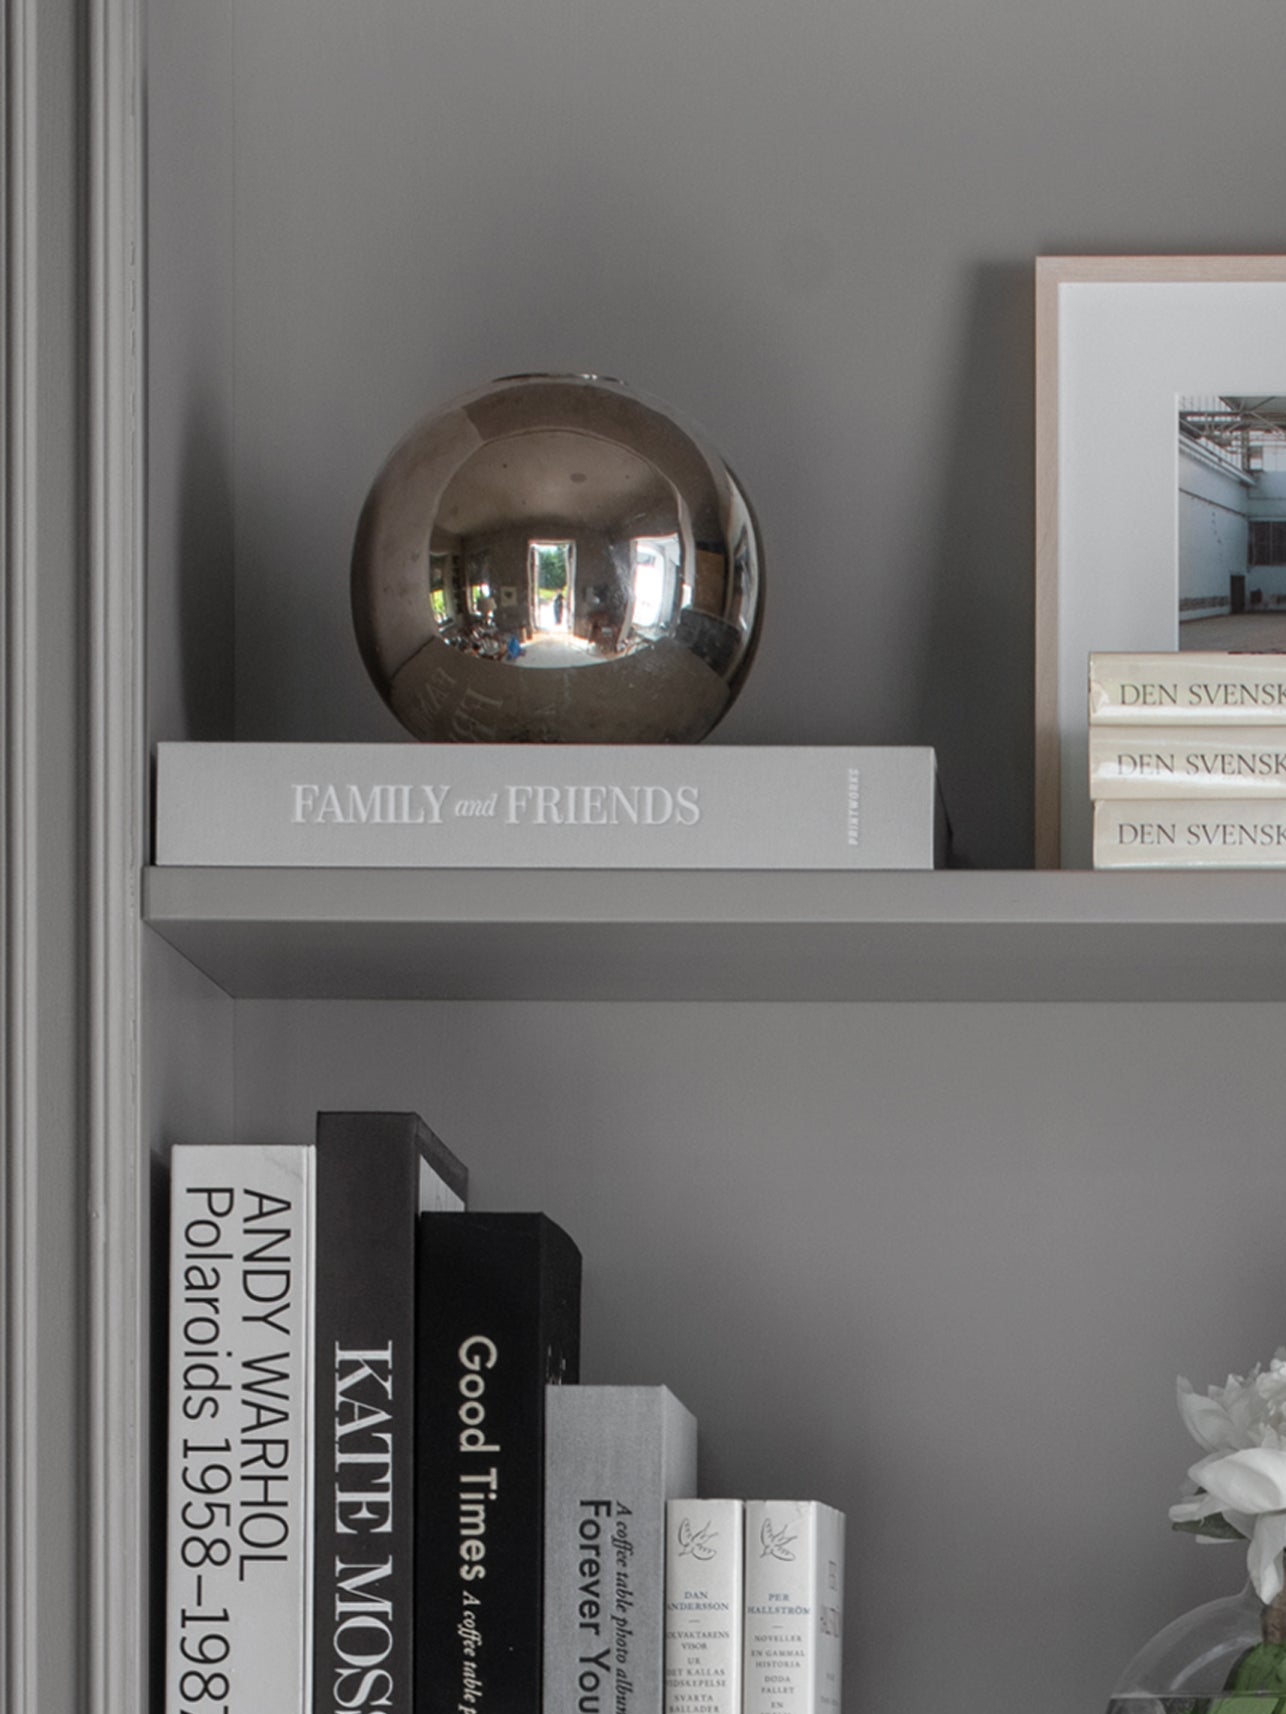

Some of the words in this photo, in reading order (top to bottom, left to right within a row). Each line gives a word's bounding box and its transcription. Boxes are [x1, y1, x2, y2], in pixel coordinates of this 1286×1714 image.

[1120, 683, 1179, 705] DEN
[1117, 753, 1176, 775] DEN
[291, 784, 449, 825] FAMILY
[454, 792, 495, 818] and
[505, 785, 701, 825] FRIENDS
[1119, 823, 1175, 844] DEN
[242, 1189, 291, 1335] ANDY
[183, 1188, 234, 1419] Polaroids
[459, 1336, 500, 1452] Good
[335, 1340, 392, 1534] KATE
[239, 1352, 290, 1581] WARHOL
[460, 1468, 497, 1581] Times
[617, 1501, 632, 1515] A
[611, 1521, 633, 1567] coffee
[579, 1500, 613, 1636] Forever
[463, 1591, 480, 1605] A
[616, 1572, 633, 1613] table
[458, 1611, 482, 1657] coffee
[611, 1615, 633, 1663] photo
[463, 1661, 482, 1703] table
